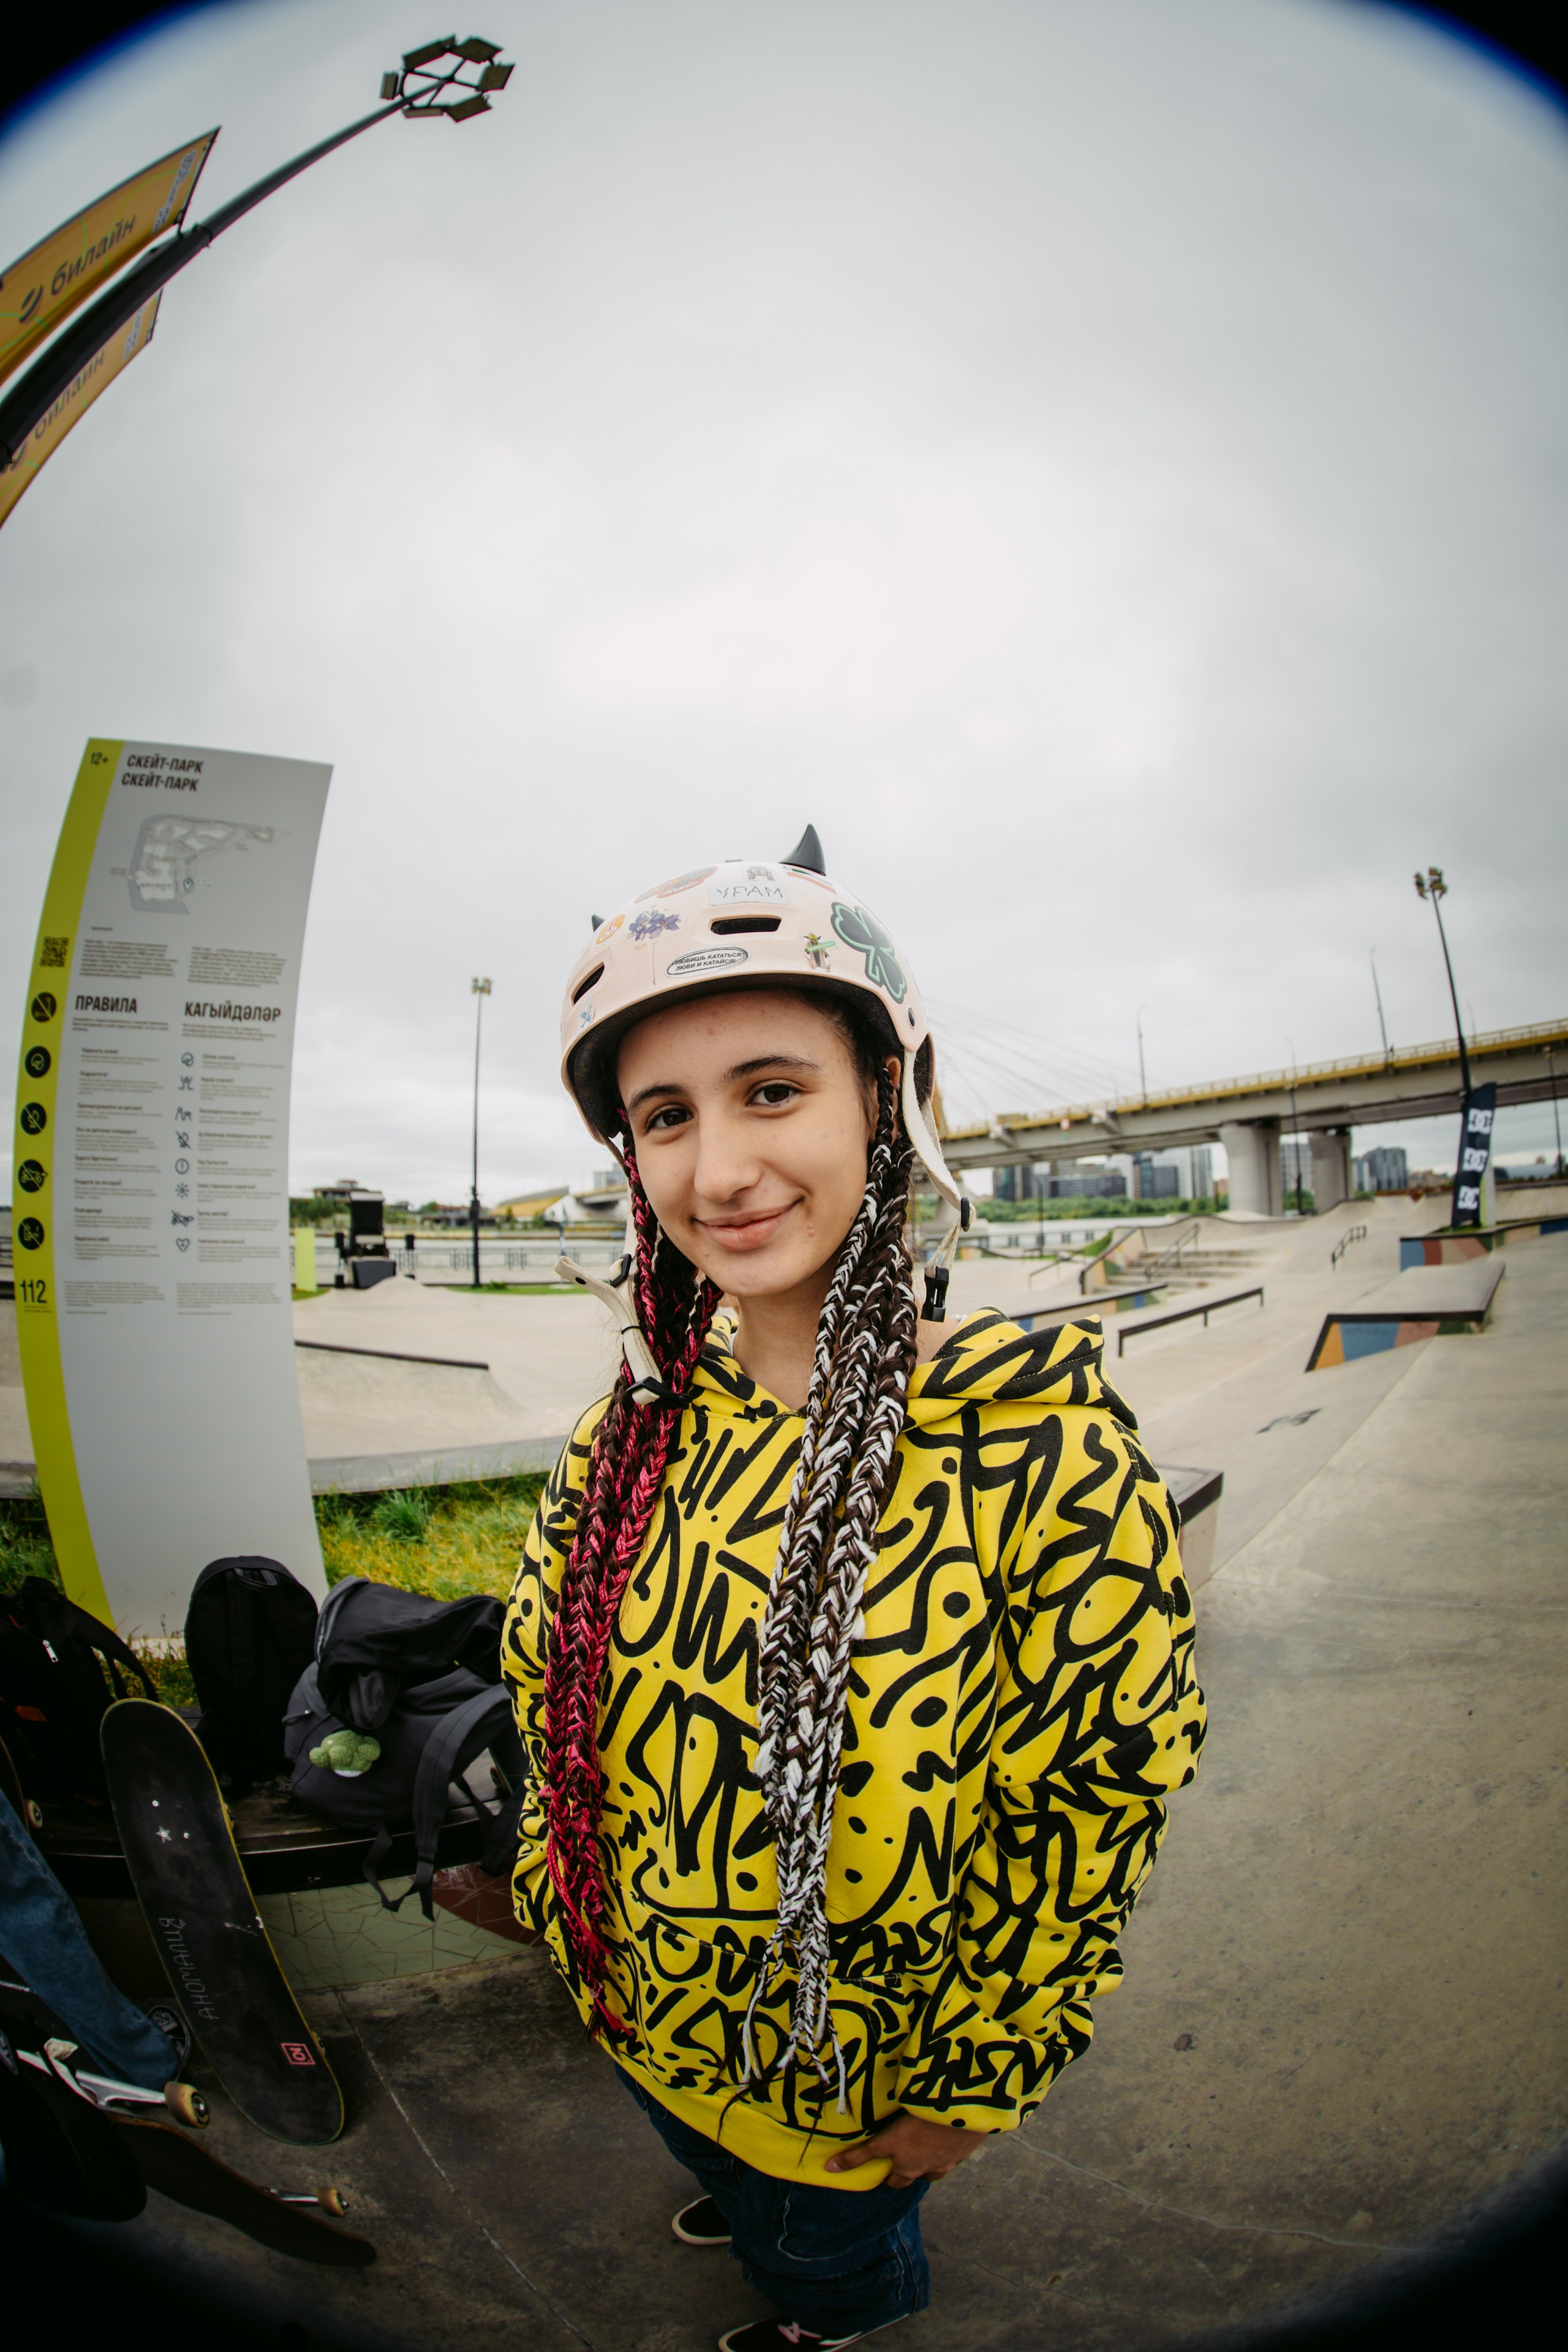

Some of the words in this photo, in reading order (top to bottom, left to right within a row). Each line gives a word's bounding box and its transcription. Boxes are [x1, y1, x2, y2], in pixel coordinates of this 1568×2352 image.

[50, 214, 137, 295] билайн
[89, 751, 108, 766] 12+
[127, 754, 203, 773] СКЕЙТ-ПАРК
[122, 772, 198, 791] СКЕЙТ-ПАРК
[717, 886, 783, 899] УРАМ
[675, 956, 706, 966] ЛЮБИШЬ
[707, 951, 745, 960] КАТАТЬСЯ?
[75, 995, 137, 1013] ПРАВИЛА
[184, 1001, 282, 1023] КАГЫЙДӘЛӘР
[1467, 1108, 1492, 1134] DC
[1463, 1147, 1488, 1172] DC
[20, 1279, 47, 1304] 112
[158, 1917, 220, 2021] АНОМАЛИЯ
